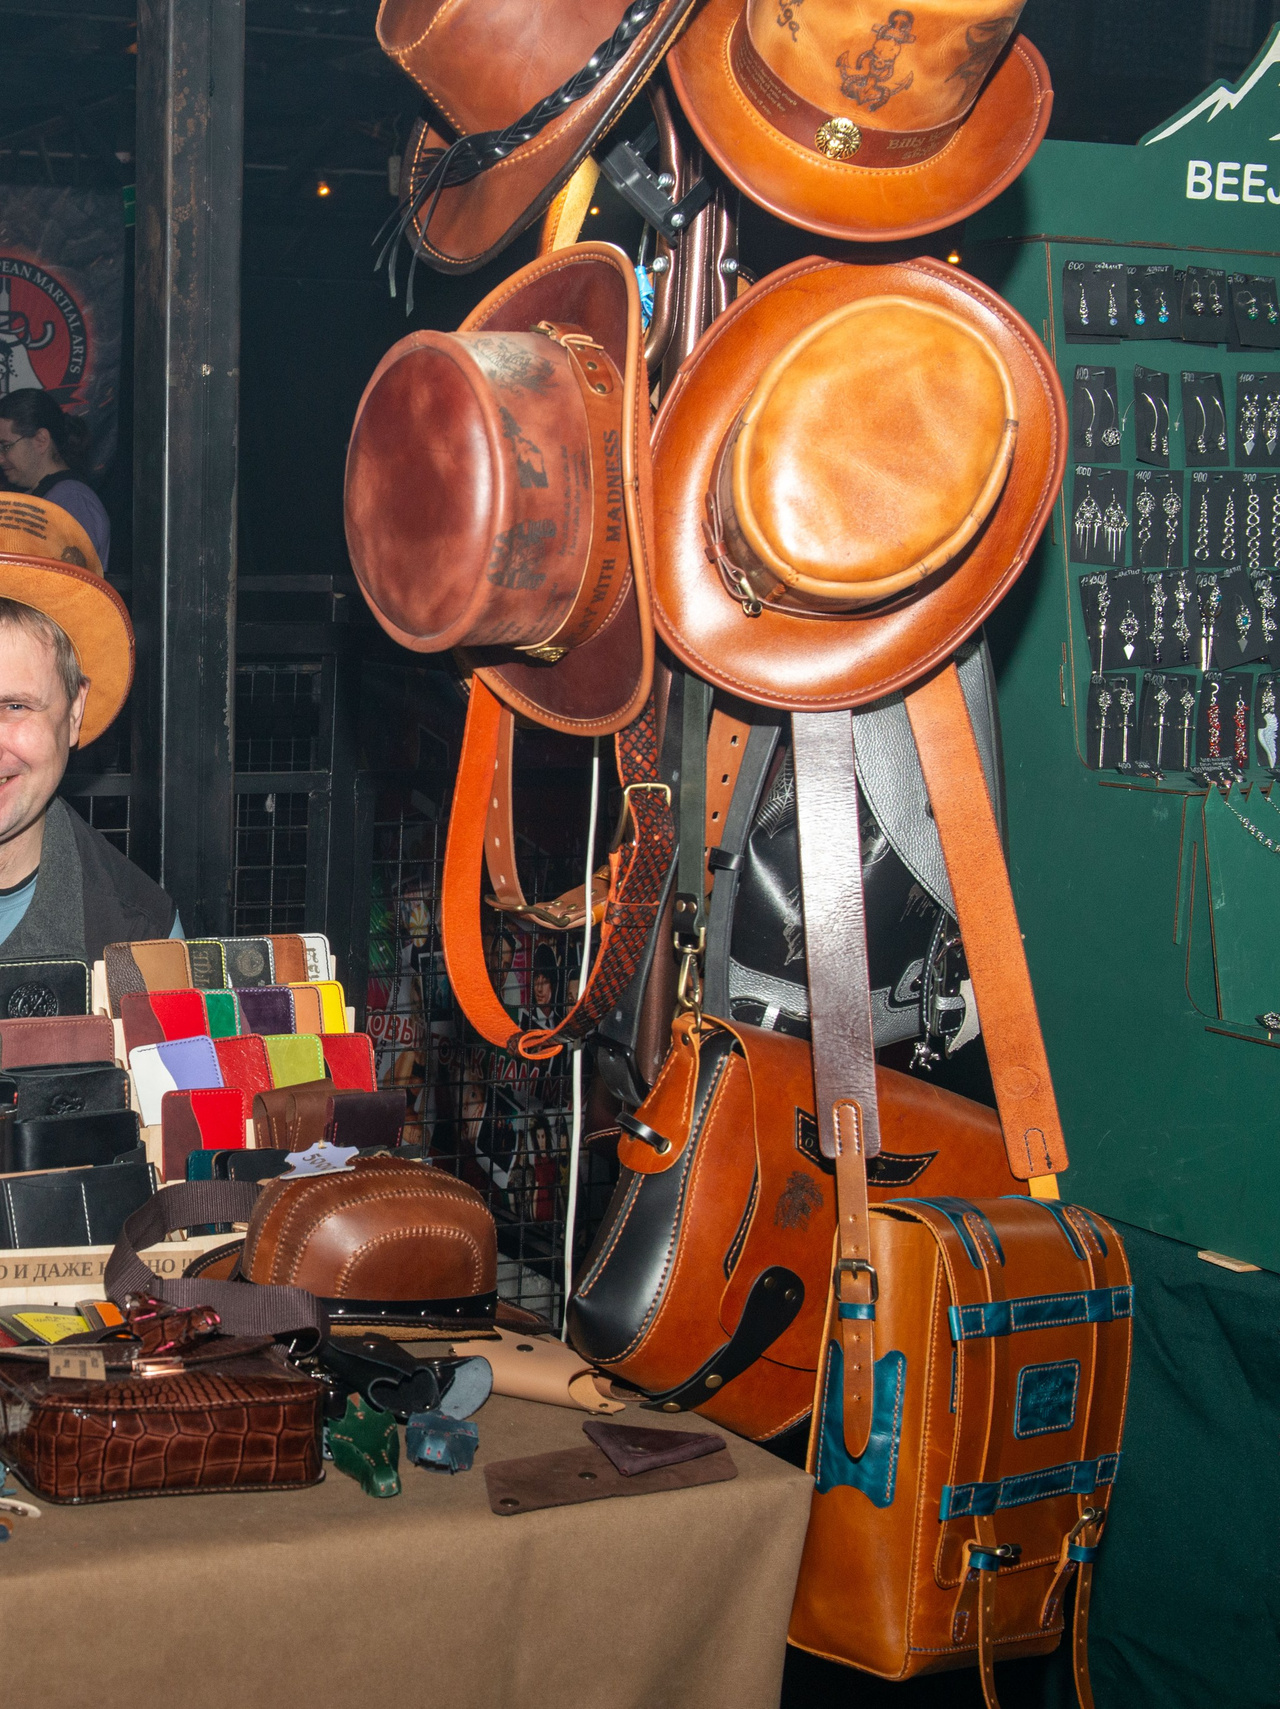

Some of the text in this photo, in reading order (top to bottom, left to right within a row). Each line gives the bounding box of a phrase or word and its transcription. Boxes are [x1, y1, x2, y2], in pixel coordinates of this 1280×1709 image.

[33, 271, 80, 331] MARTIAL
[70, 334, 85, 374] ARTS
[603, 428, 623, 543] MADNESS
[1075, 466, 1092, 477] 1000
[592, 557, 616, 606] WITH
[13, 1263, 29, 1279] И
[33, 1261, 94, 1282] ДАЖЕ
